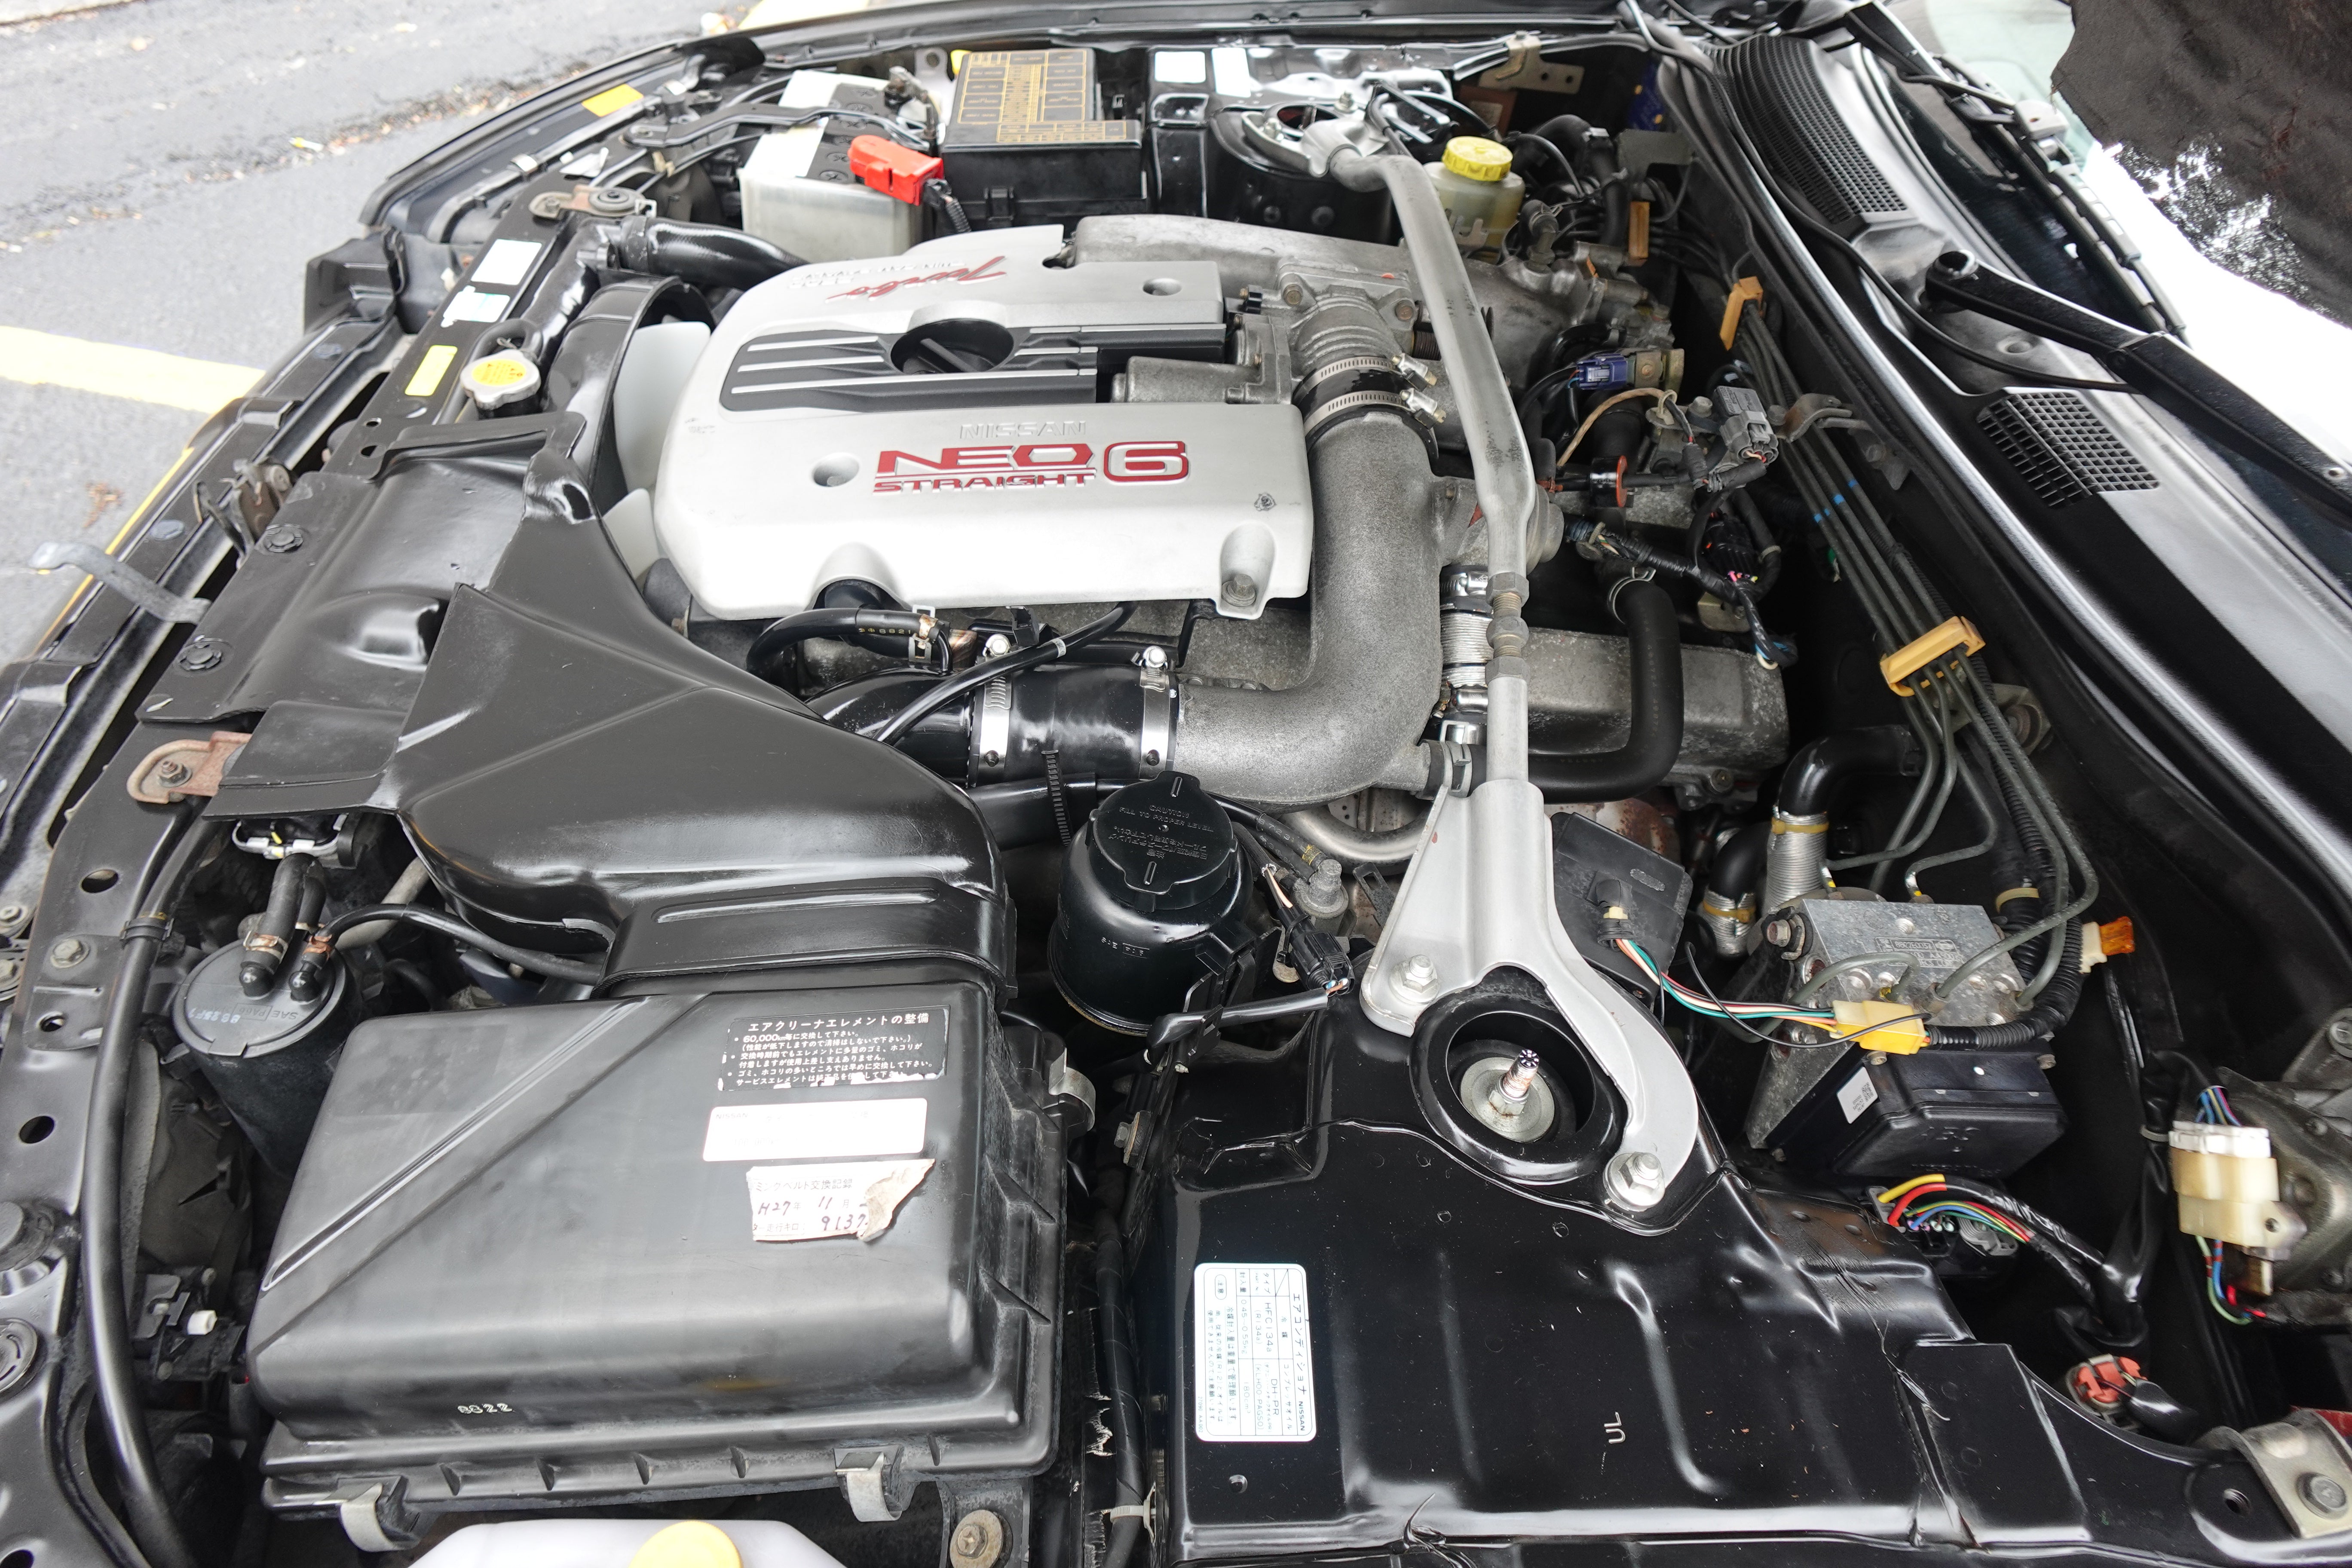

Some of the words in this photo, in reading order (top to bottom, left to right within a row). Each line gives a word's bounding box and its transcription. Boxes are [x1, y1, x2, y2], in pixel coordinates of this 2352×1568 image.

[825, 255, 1007, 303] Turbo
[959, 420, 1087, 440] NISSAN
[876, 443, 1095, 476] NEO
[1103, 441, 1189, 486] 6
[873, 473, 1096, 496] STRAIGHT
[1119, 806, 1136, 815] FILL
[1153, 814, 1185, 826] PROPER
[1148, 805, 1190, 819] CAUTION
[271, 1010, 299, 1020] SAE
[747, 1012, 930, 1032] エアクリーナエレメントの整備
[738, 1061, 933, 1078] ゴミ、ホコリの多いところでは早めに交換して下さい。
[739, 1054, 885, 1069] 付着しますが使用上差し支えありません。
[1217, 1280, 1224, 1294] 注意
[1254, 1310, 1262, 1344] (R134a)
[1265, 1303, 1274, 1352] HFC134a
[1292, 1293, 1307, 1395] エアコンディショナ
[1271, 1378, 1279, 1415] DH-PR
